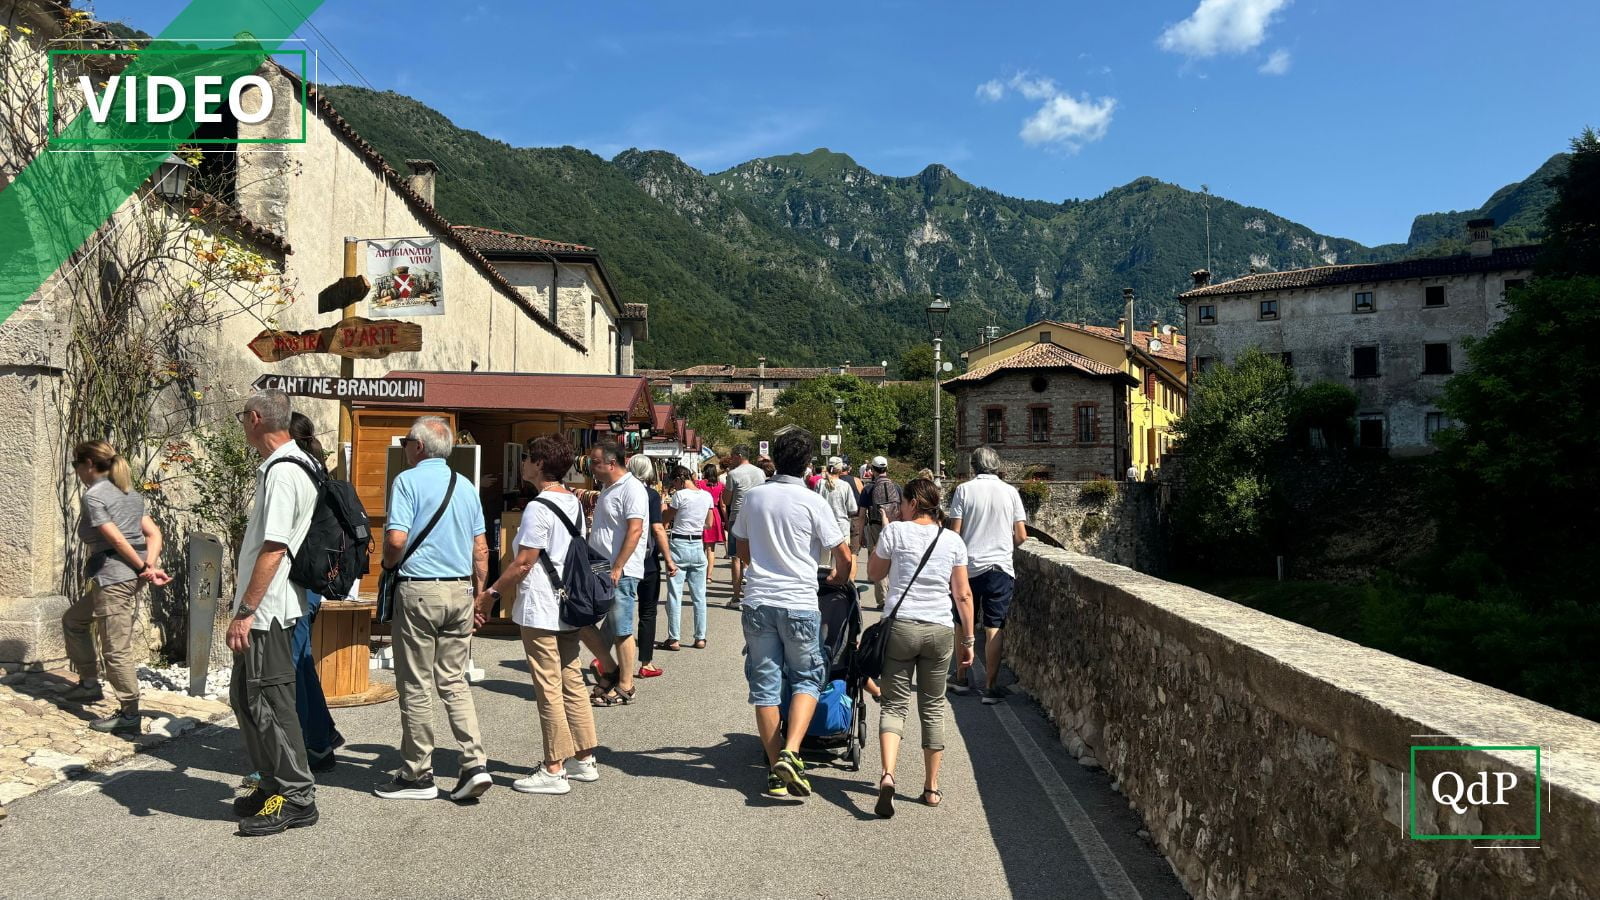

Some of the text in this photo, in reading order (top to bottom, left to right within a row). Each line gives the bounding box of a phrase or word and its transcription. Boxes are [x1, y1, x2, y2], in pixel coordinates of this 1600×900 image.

[376, 247, 432, 258] ARTIGIANATO
[273, 325, 399, 351] MOSTRA D'ARTE
